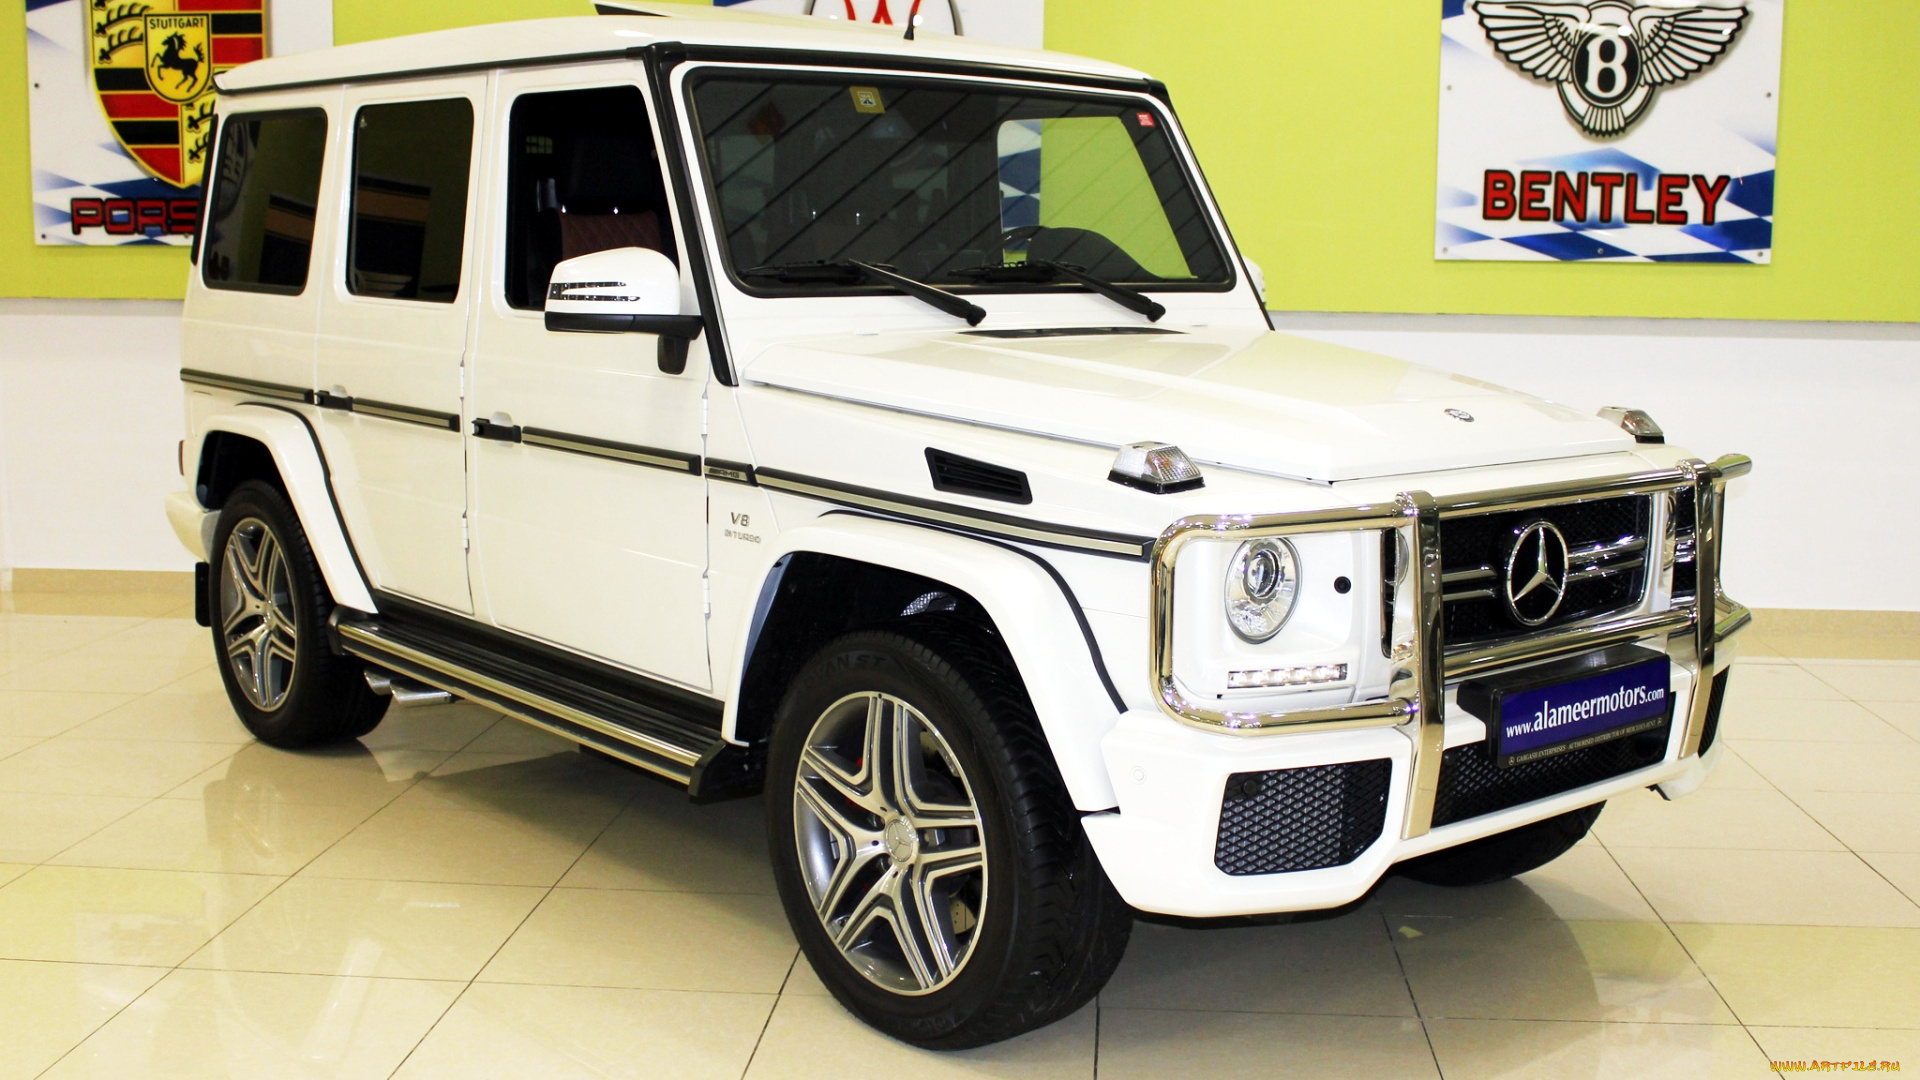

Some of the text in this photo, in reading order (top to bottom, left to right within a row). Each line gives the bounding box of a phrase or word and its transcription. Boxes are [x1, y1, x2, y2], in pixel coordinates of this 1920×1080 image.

[149, 17, 205, 30] STUTTGART
[1482, 168, 1731, 226] BENTLEY
[70, 197, 199, 235] PORS
[731, 511, 751, 527] V8
[724, 529, 762, 544] BITURBO
[1505, 684, 1665, 738] www.alameermotors.com
[1538, 745, 1567, 758] ENTERPRISES
